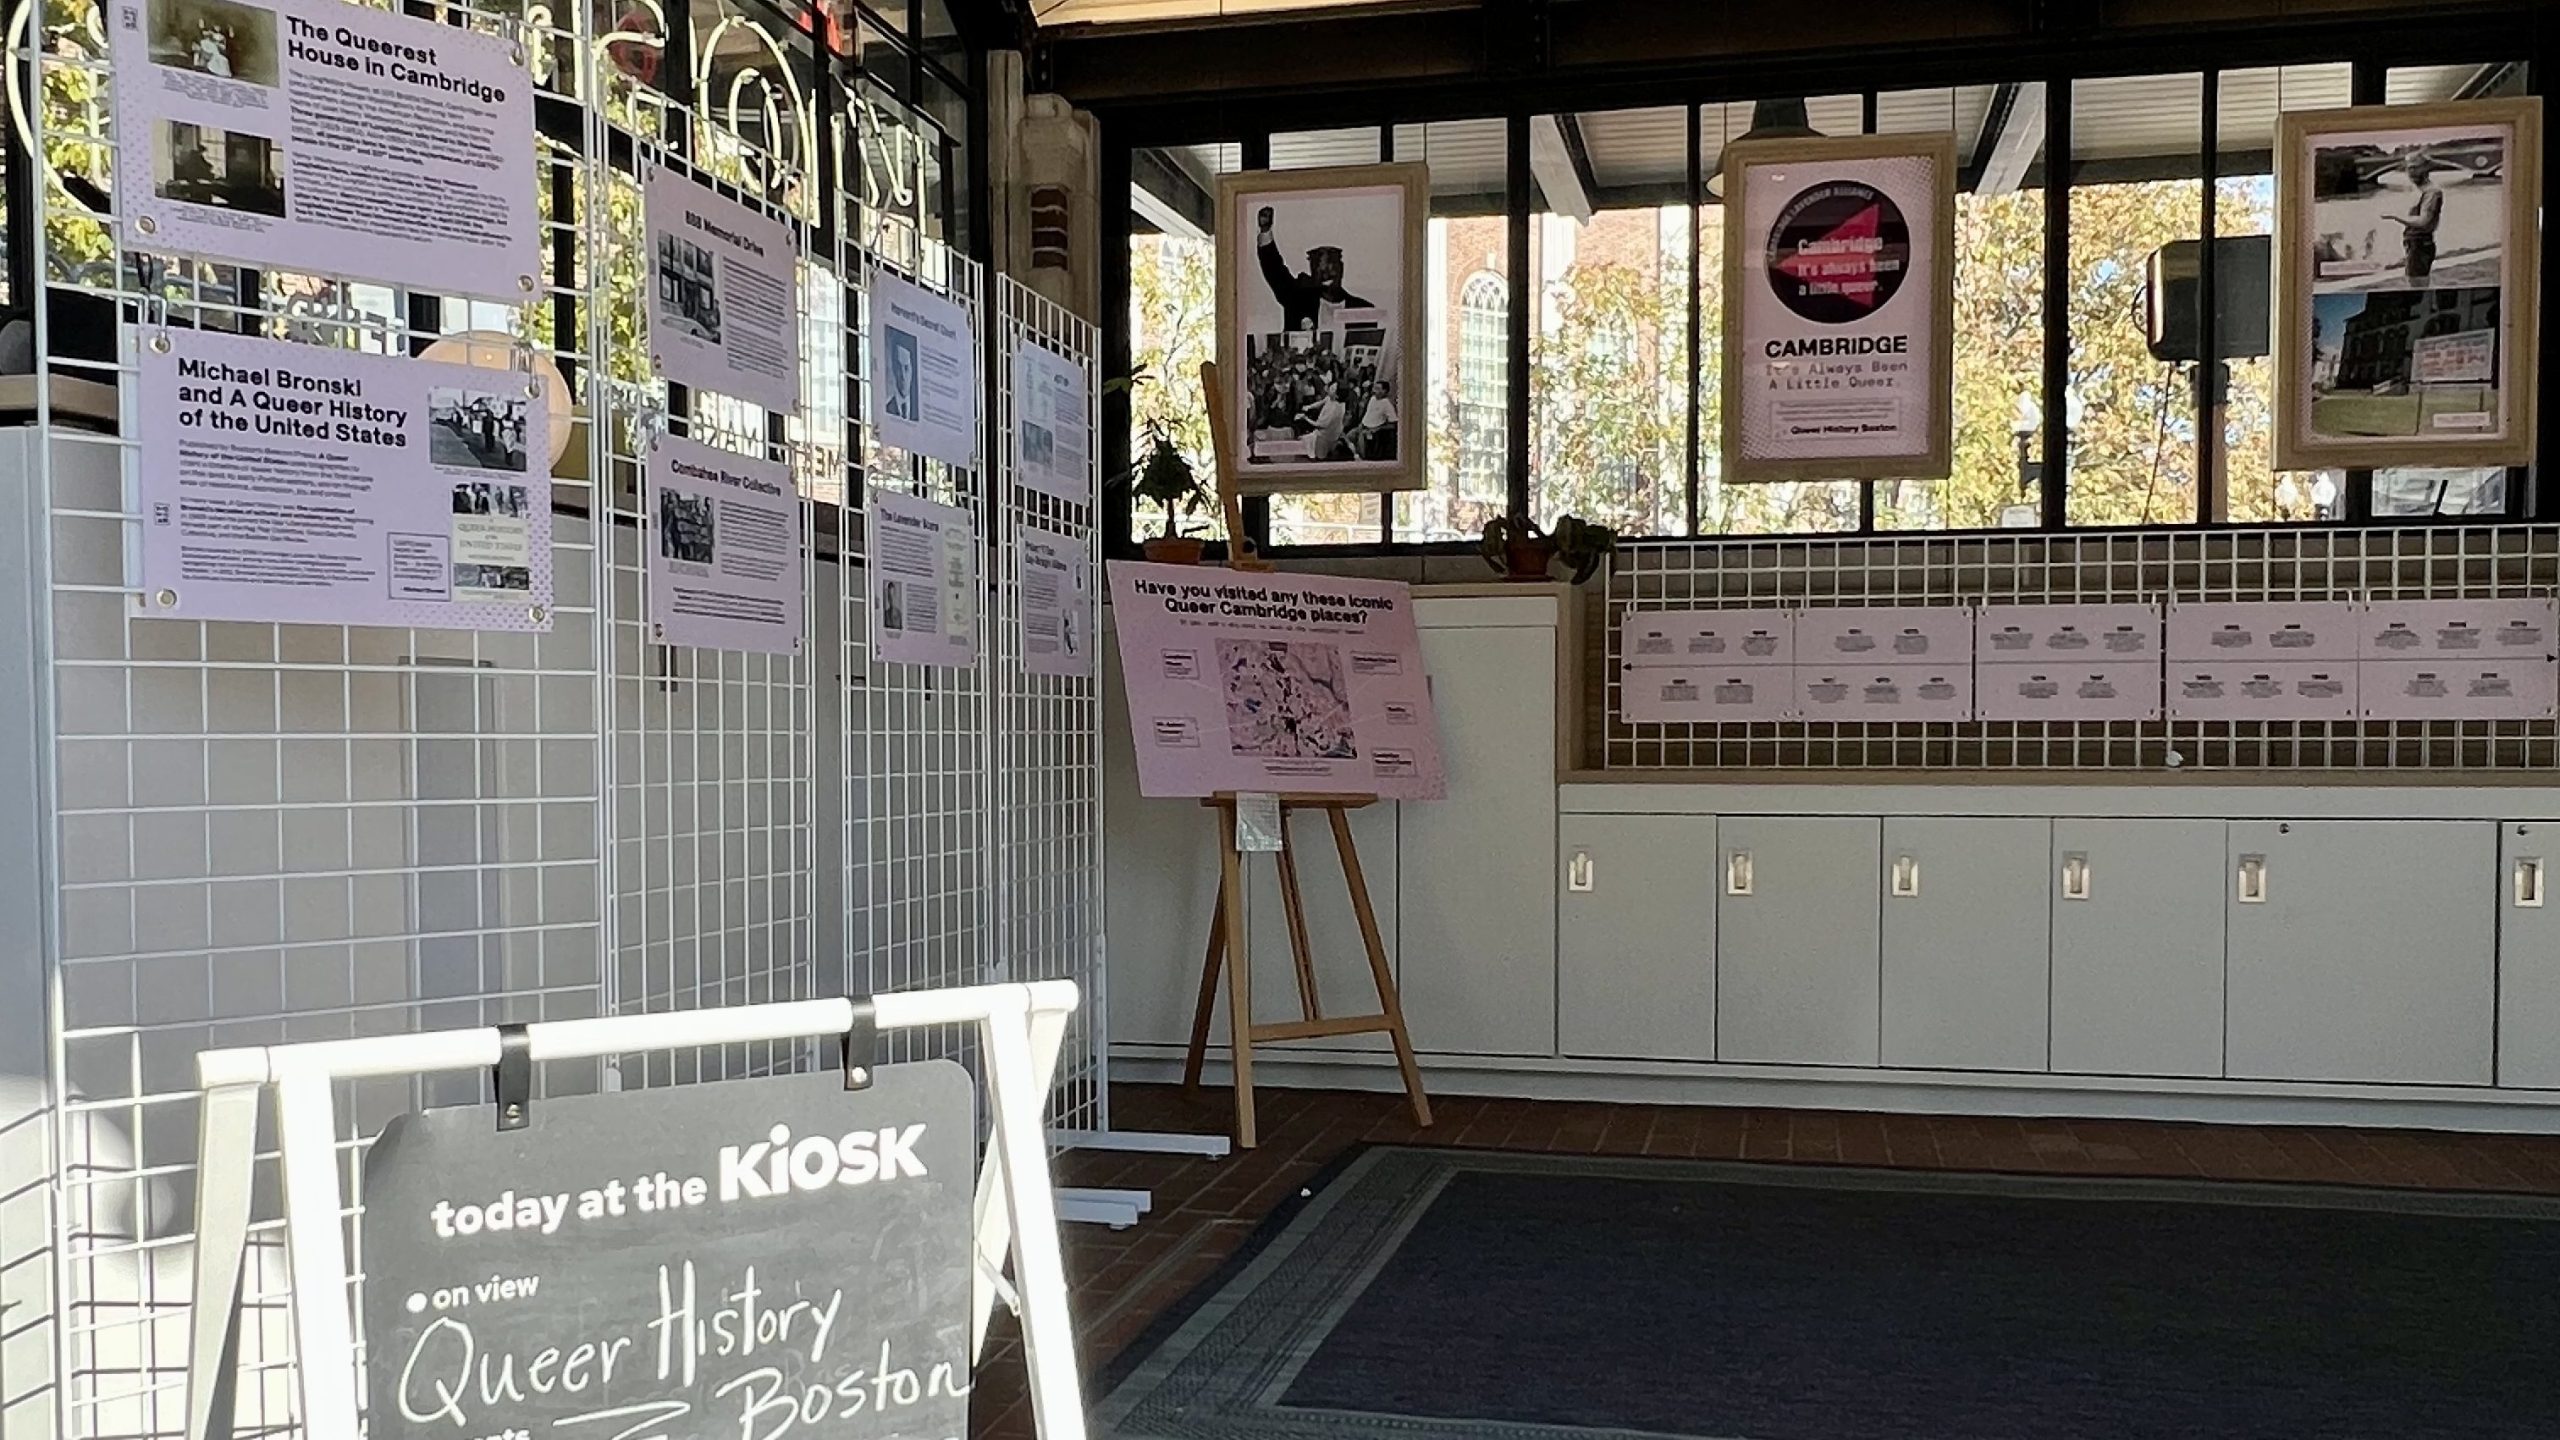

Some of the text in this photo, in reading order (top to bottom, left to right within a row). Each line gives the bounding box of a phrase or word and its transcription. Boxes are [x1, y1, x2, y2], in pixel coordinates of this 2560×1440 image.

[286, 15, 437, 66] The Queerest
[288, 40, 359, 71] House
[366, 56, 384, 76] in
[392, 62, 505, 103] Cambridge
[704, 218, 741, 247] Memorial
[743, 235, 764, 258] Drive
[1798, 235, 1884, 256] Cambridge
[1765, 335, 1908, 358] CAMBRIDGE
[178, 358, 361, 396] Michael Bronski
[1769, 378, 1778, 390] A
[1786, 377, 1840, 390] Little
[1809, 362, 1862, 375] Always
[1871, 360, 1908, 373] Been
[179, 386, 408, 428] and A Queer History
[180, 409, 406, 447] of the United States
[1134, 579, 1394, 612] Have you visited any these iconic
[1165, 598, 1368, 625] Queer Cambridge places?
[431, 1190, 570, 1239] today
[577, 1179, 626, 1221] at
[634, 1172, 708, 1214] the
[432, 1272, 540, 1309] on view
[398, 1259, 843, 1427] Queer History
[715, 1338, 973, 1440] Boston
